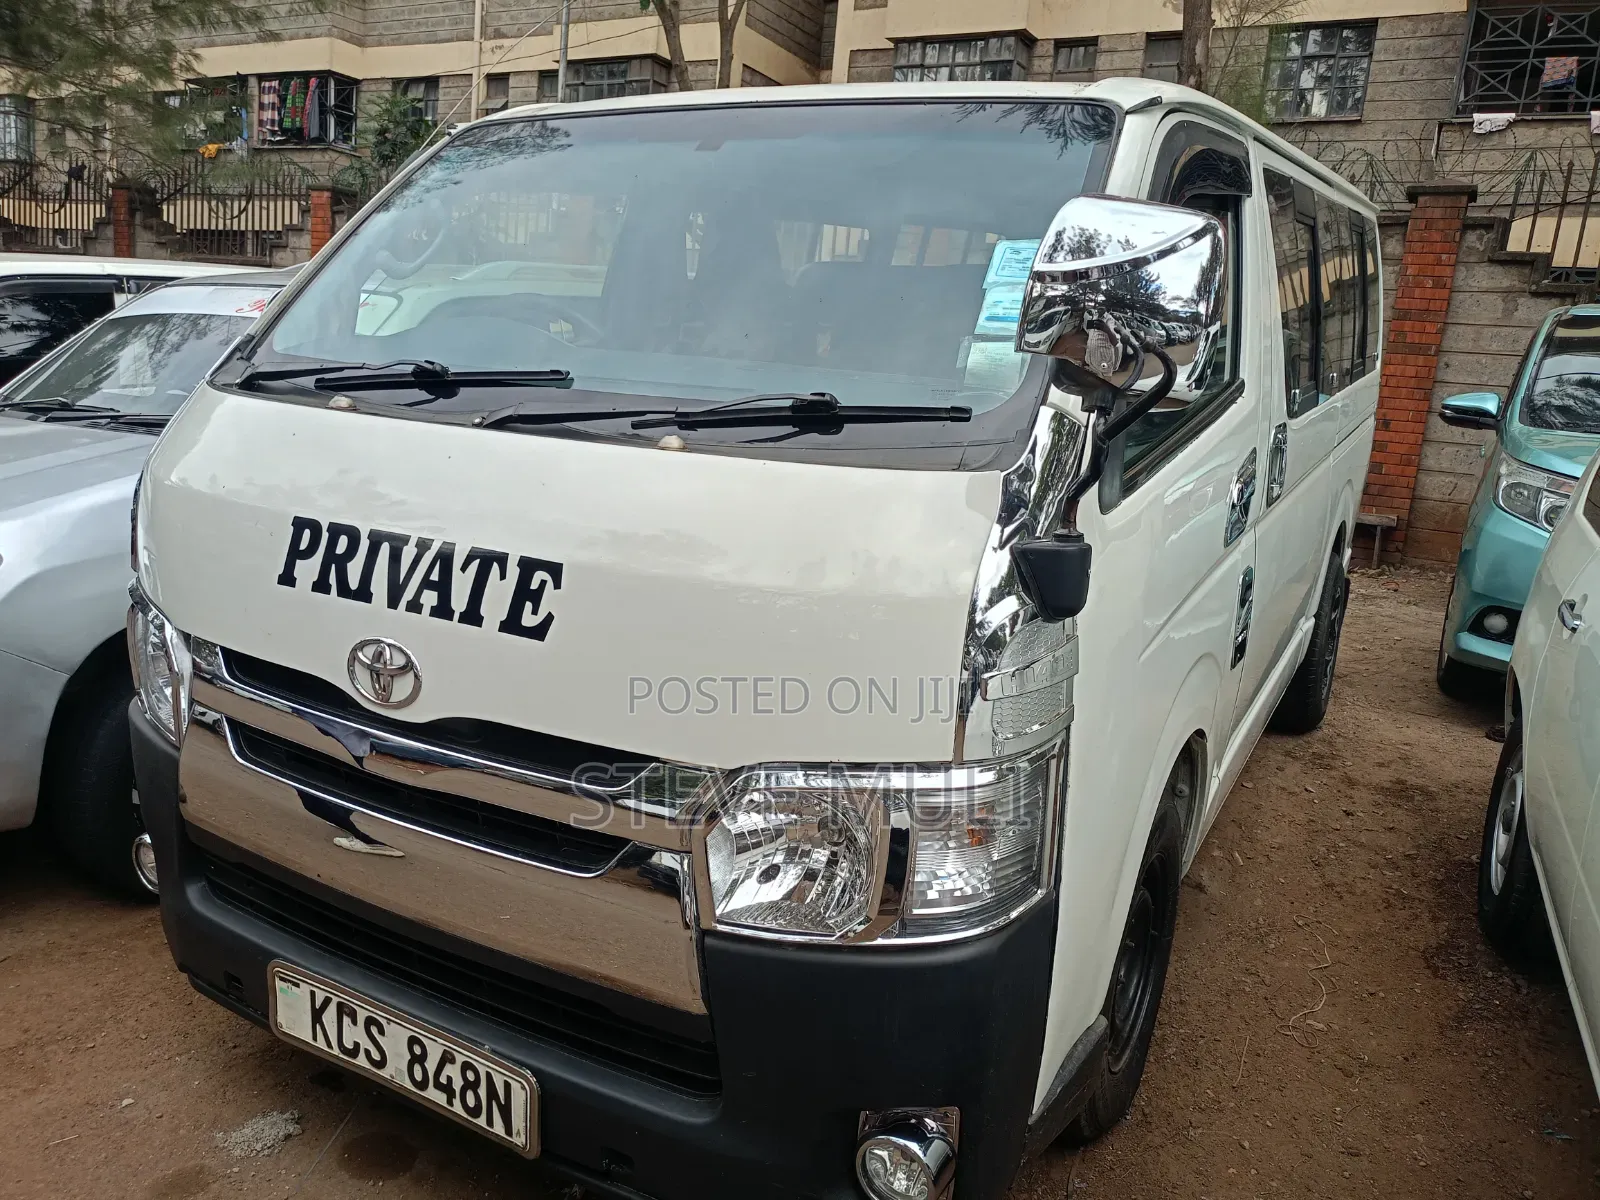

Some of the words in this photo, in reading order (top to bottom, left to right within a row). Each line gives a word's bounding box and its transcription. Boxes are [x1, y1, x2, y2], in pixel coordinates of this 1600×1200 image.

[277, 516, 563, 642] PRIVATE
[309, 989, 388, 1070] KCS
[406, 1034, 514, 1138] 848N
